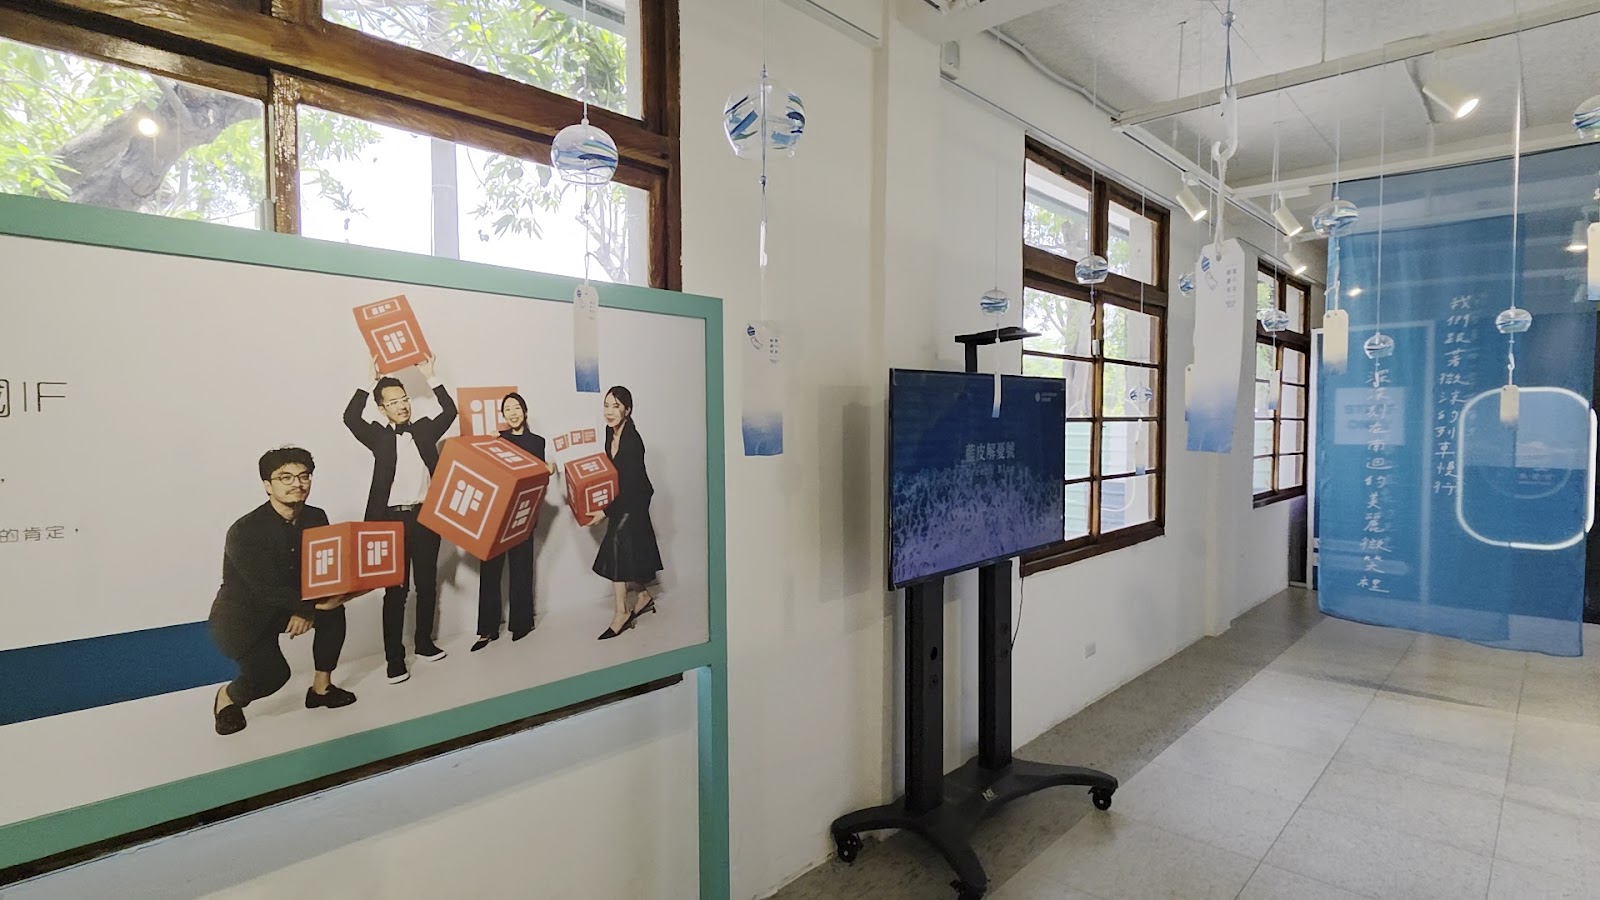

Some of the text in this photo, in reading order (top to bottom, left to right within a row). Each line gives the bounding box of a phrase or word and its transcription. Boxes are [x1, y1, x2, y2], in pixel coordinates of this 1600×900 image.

[449, 479, 484, 517] iF
[316, 548, 334, 576] iF
[367, 540, 388, 566] iF
